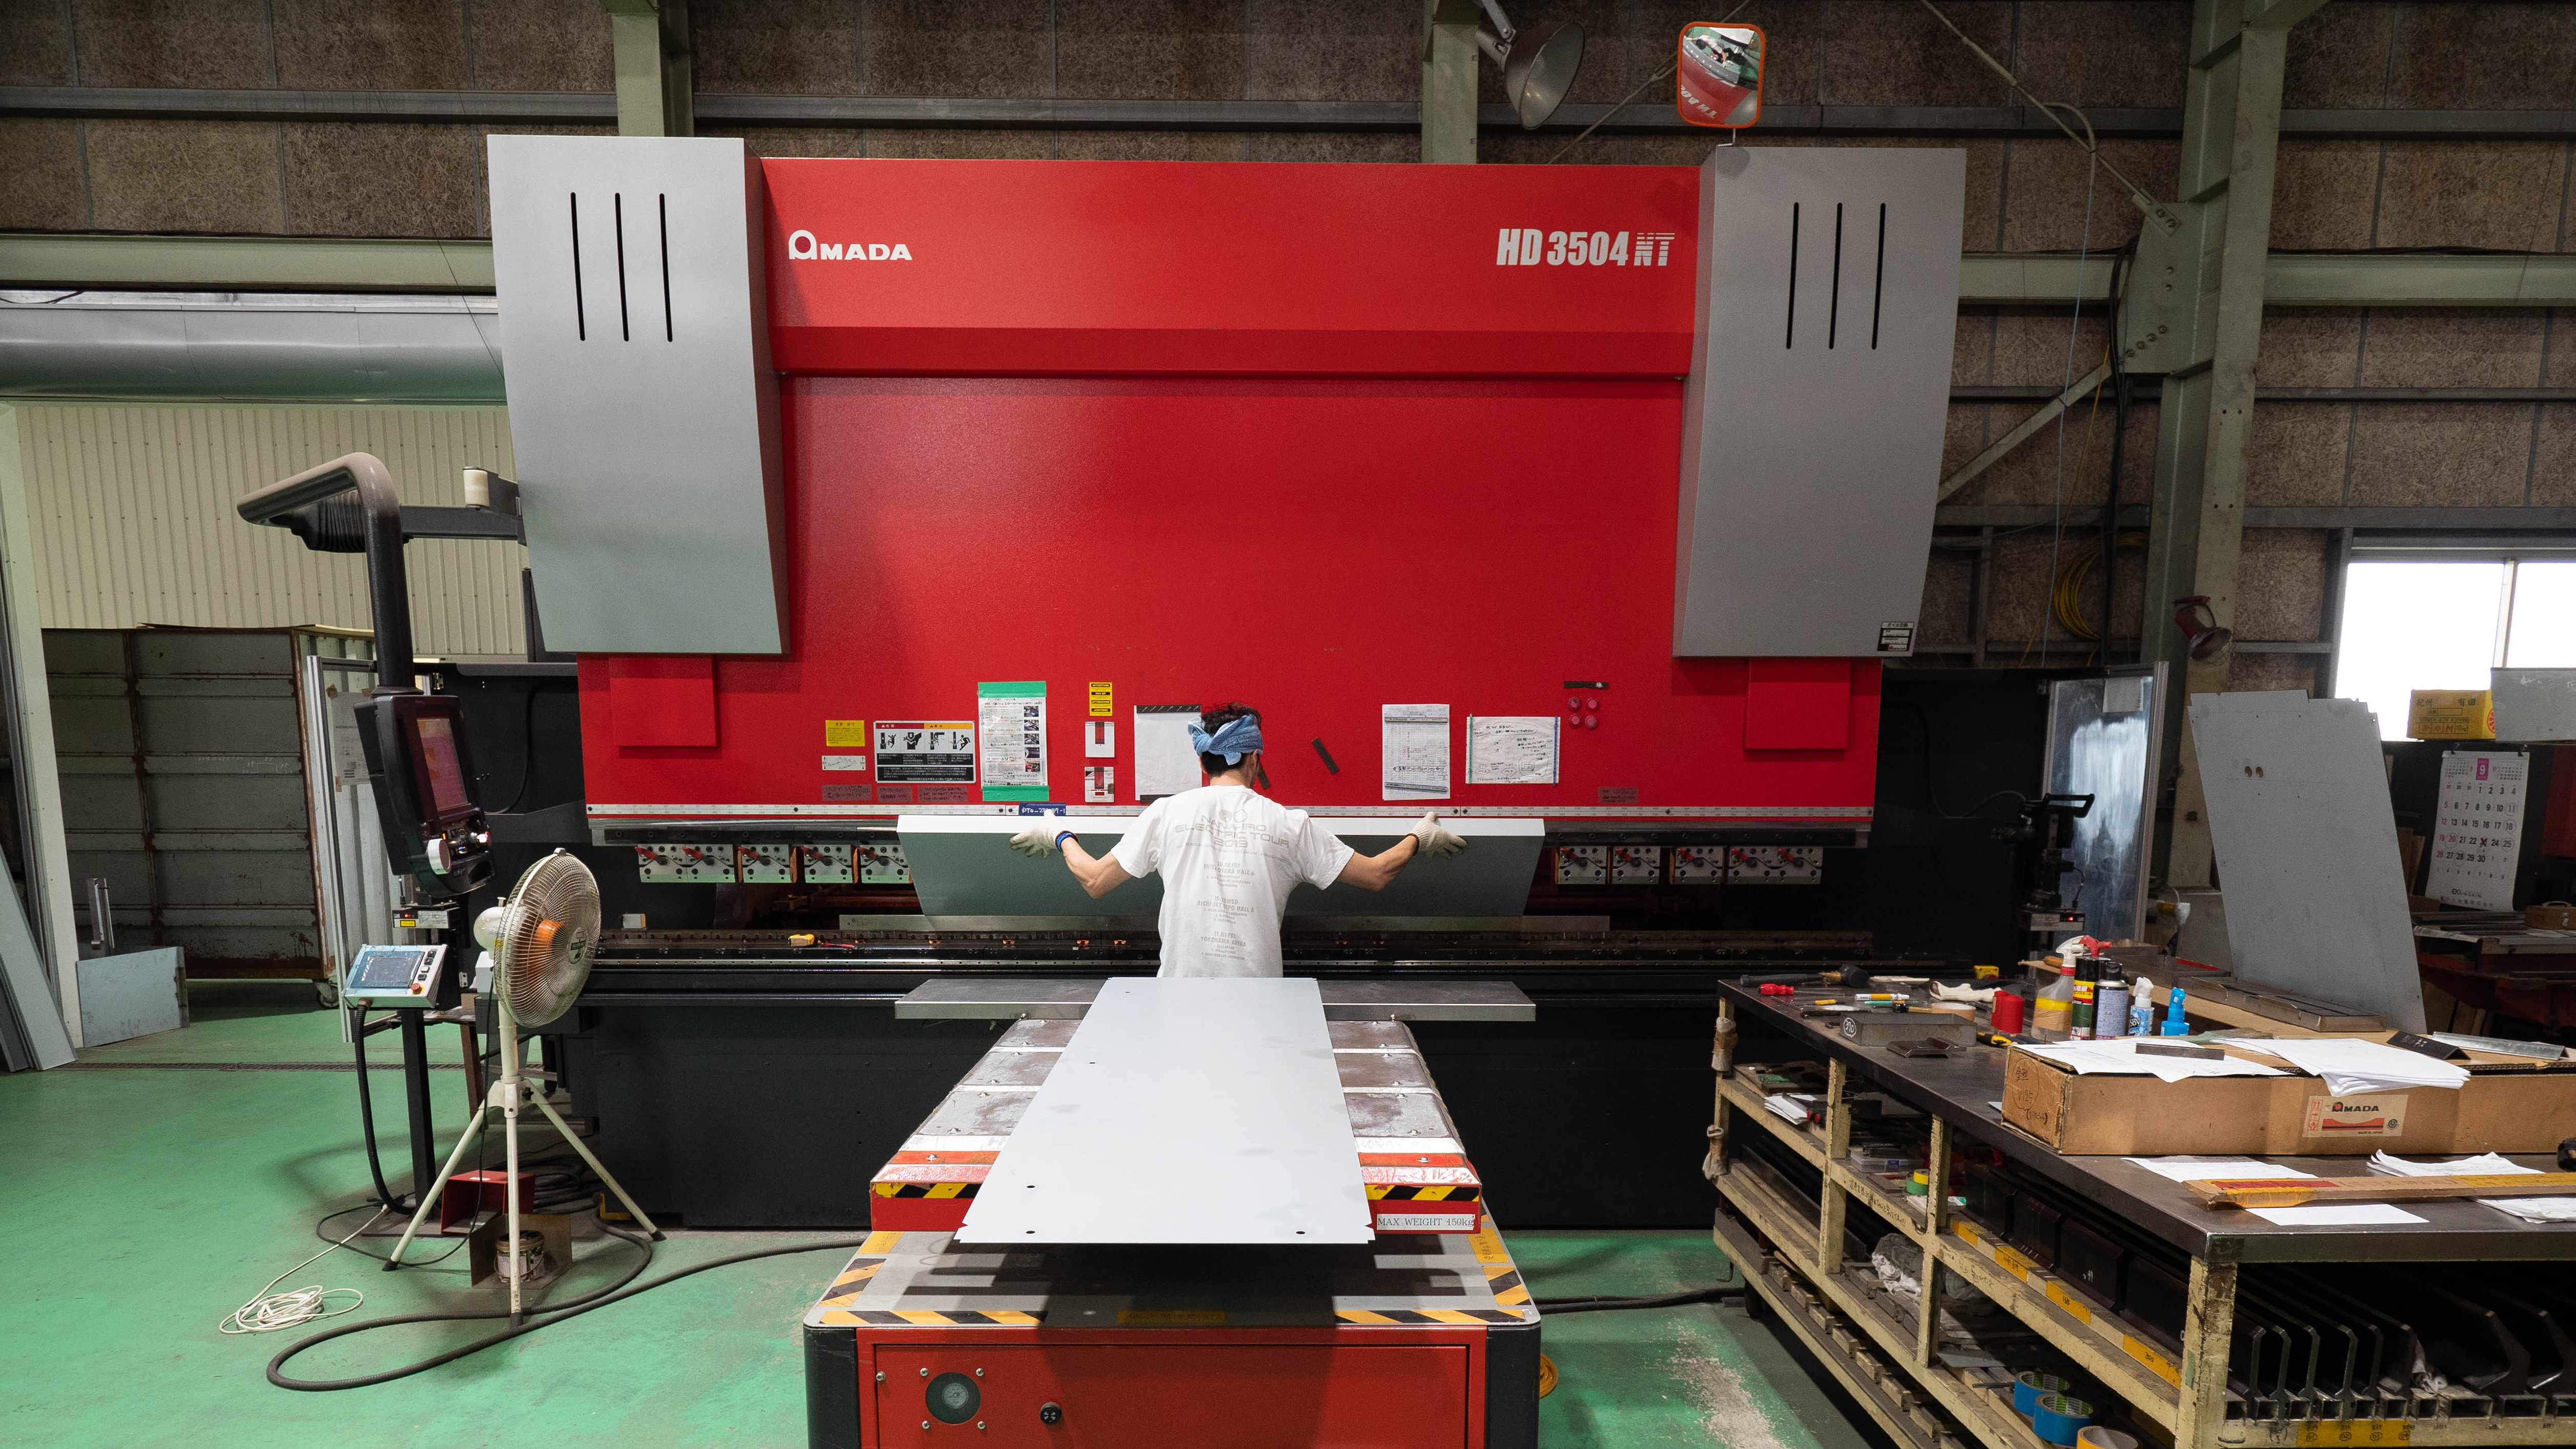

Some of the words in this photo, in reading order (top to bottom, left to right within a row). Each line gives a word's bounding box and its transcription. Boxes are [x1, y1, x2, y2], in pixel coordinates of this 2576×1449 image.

[788, 229, 913, 261] AMADA
[1496, 228, 1543, 266] HD
[1547, 231, 1630, 266] 3504
[2480, 765, 2486, 775] 9
[1201, 815, 1266, 832] NANA-IRO
[1175, 823, 1247, 839] ELECTRIC
[1250, 832, 1290, 848] TOUR
[1213, 837, 1248, 848] 2019
[2332, 1102, 2379, 1112] AMADA
[1404, 1217, 1443, 1226] WEIGHT
